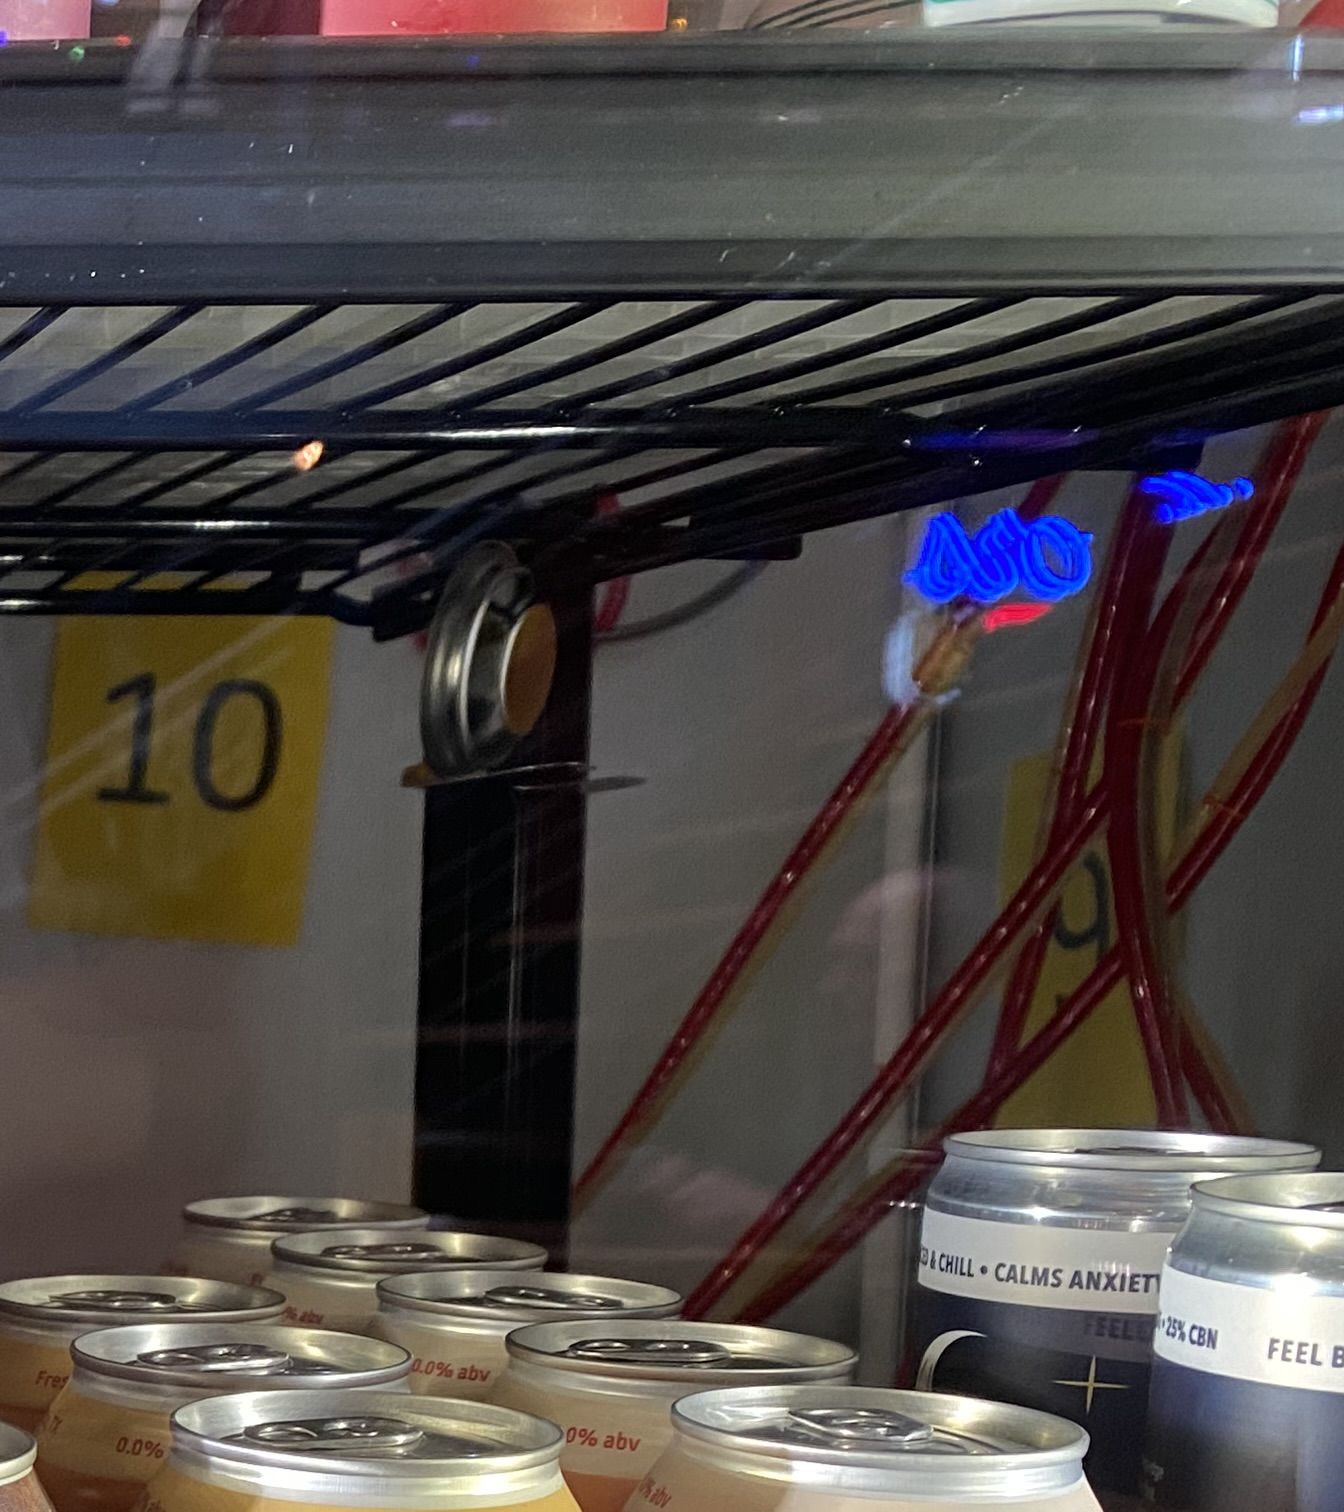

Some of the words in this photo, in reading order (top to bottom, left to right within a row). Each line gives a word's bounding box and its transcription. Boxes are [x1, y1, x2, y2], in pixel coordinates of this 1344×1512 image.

[99, 671, 283, 812] 10
[939, 1253, 975, 1277] CHILL
[995, 1262, 1063, 1288] CALMS
[1188, 1324, 1219, 1351] CBN
[1267, 1337, 1324, 1367] FEEL
[34, 1371, 69, 1389] Fres
[458, 1364, 491, 1382] abv
[115, 1436, 165, 1460] 0.0%
[603, 1429, 642, 1453] abv
